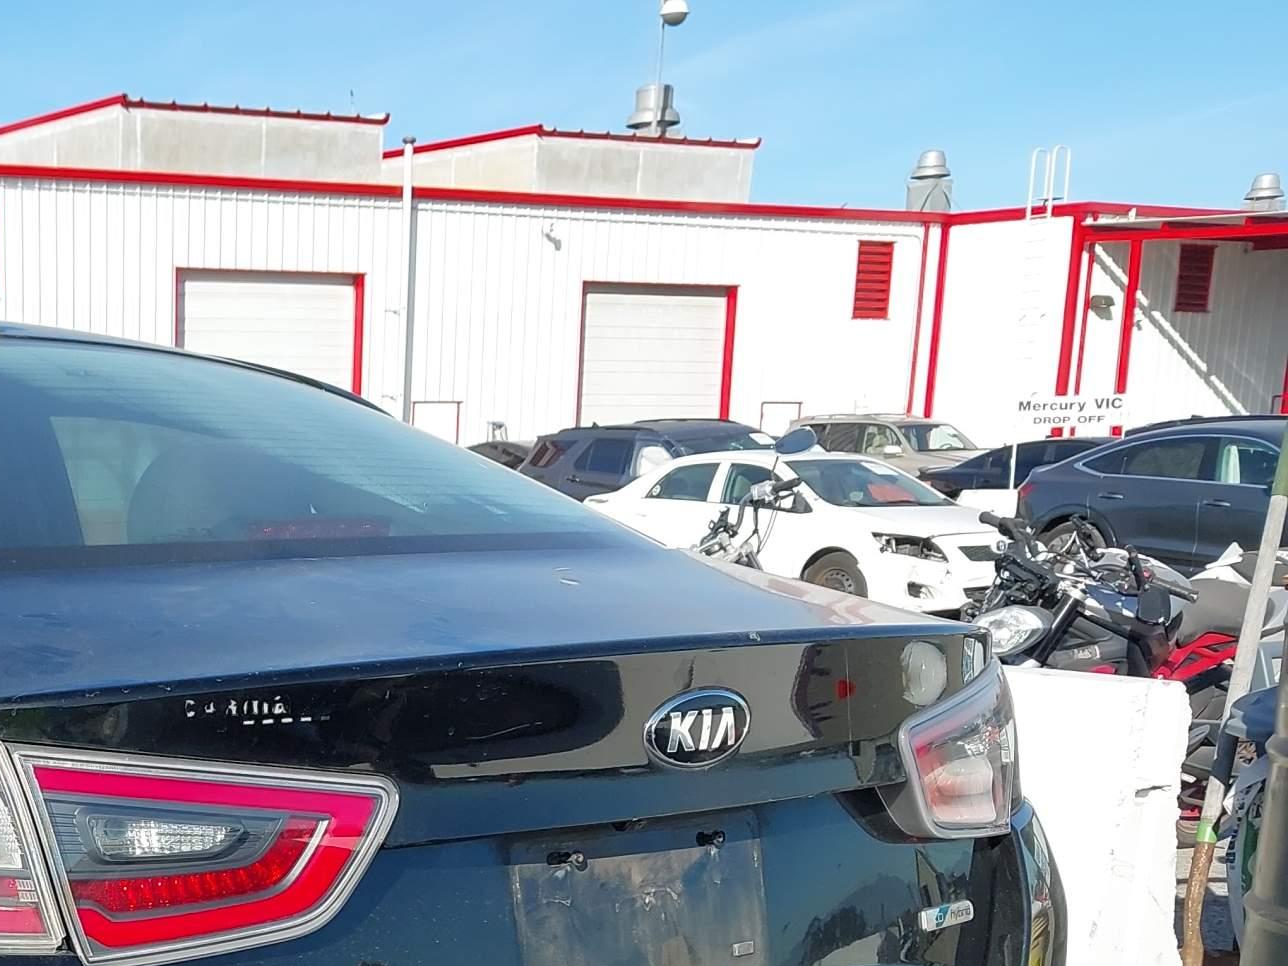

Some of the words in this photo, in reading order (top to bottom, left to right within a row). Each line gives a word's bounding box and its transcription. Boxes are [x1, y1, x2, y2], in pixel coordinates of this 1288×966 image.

[1018, 401, 1086, 412] Mercury
[1094, 398, 1123, 409] VIC
[1033, 416, 1071, 425] DROP
[1077, 415, 1105, 424] OFF
[667, 706, 736, 753] KIA
